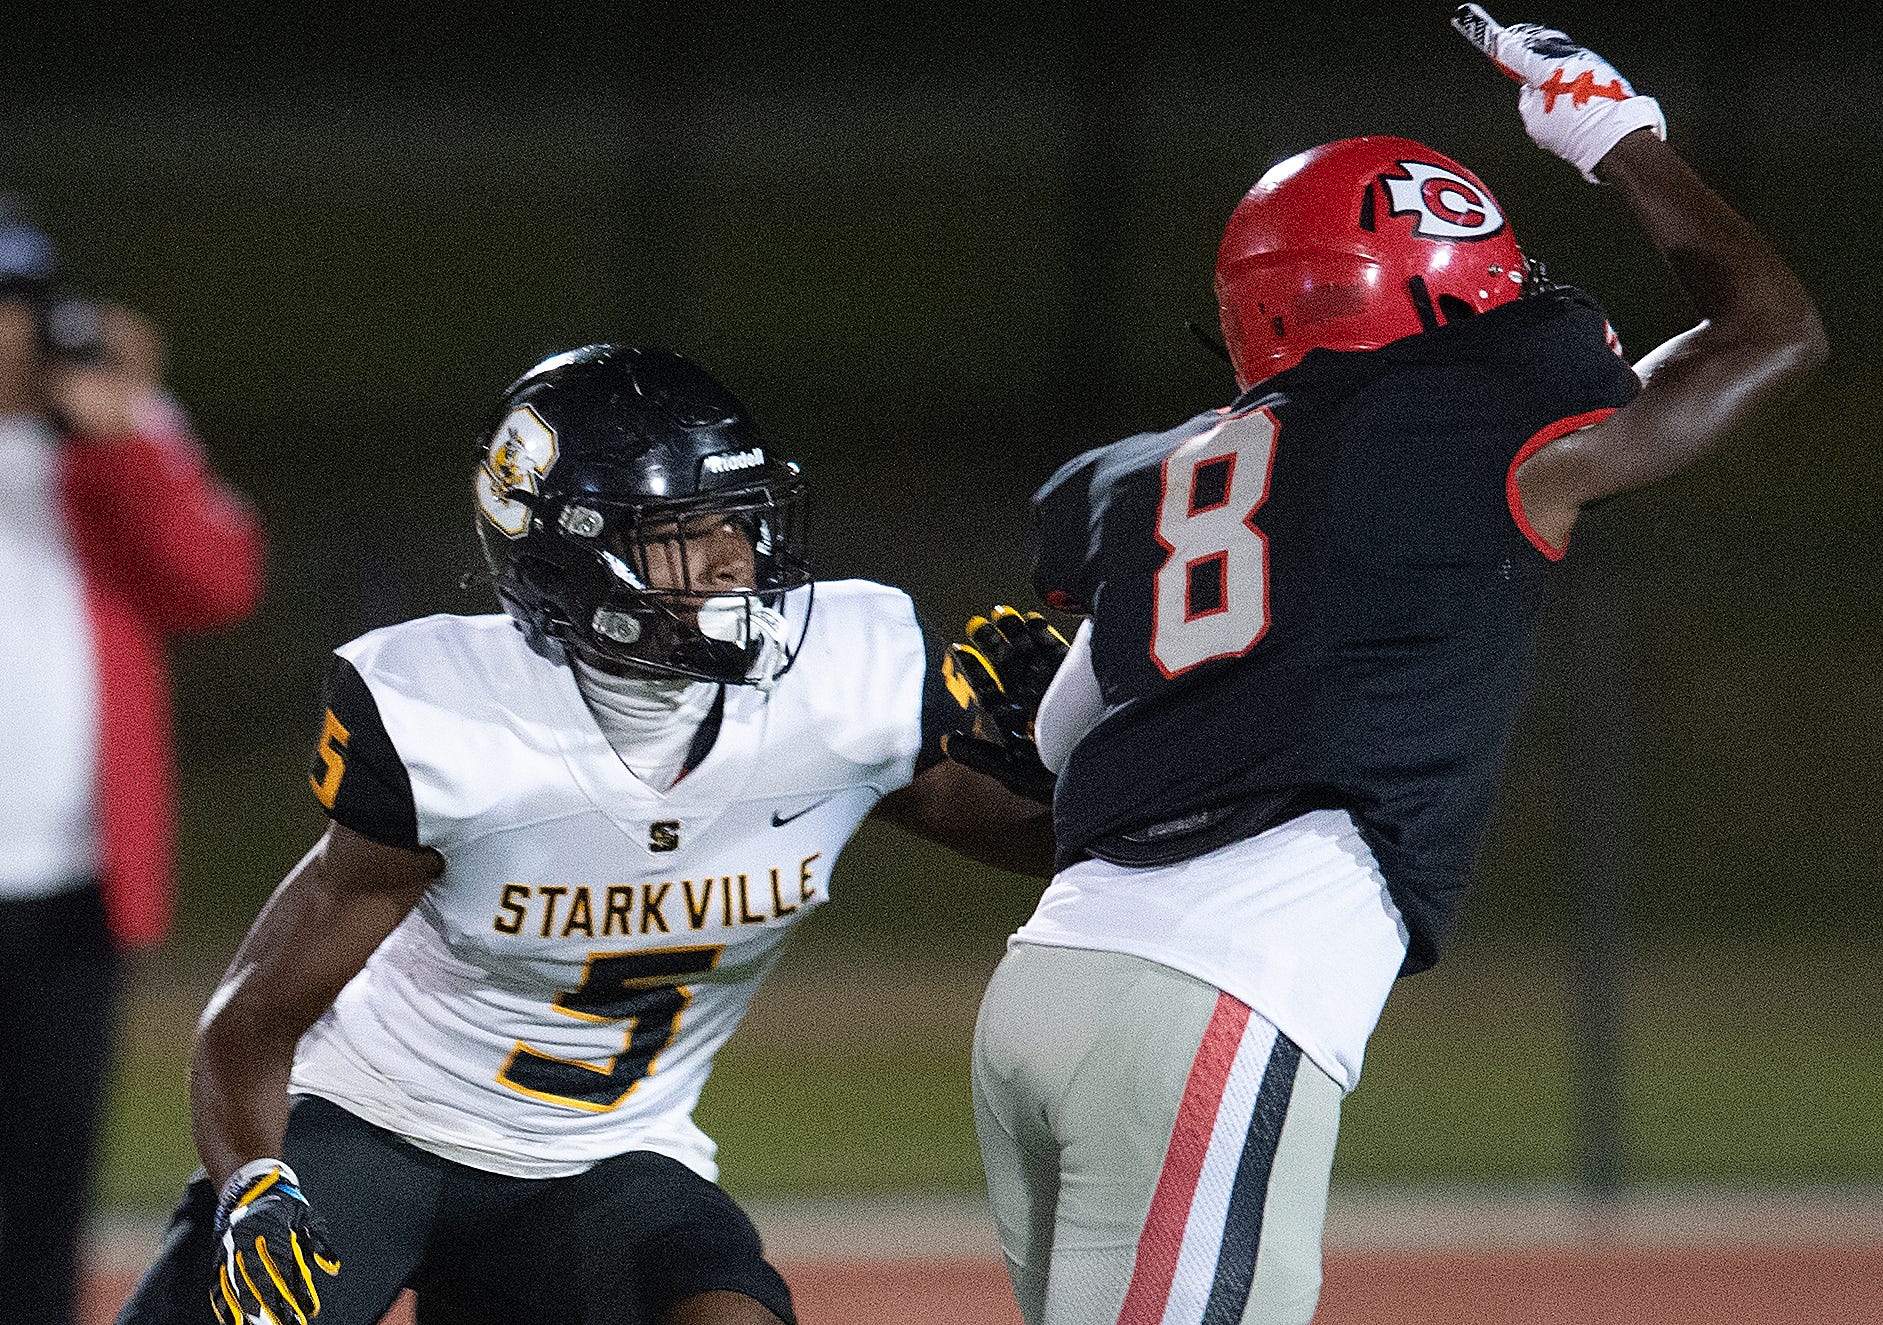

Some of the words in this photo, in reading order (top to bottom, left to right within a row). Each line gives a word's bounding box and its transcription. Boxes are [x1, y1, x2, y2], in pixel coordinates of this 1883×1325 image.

[1420, 176, 1487, 229] C
[1149, 405, 1283, 681] 8
[308, 706, 351, 810] 5
[648, 820, 681, 853] S
[493, 852, 824, 939] STARKVILLE
[496, 943, 727, 1114] 5
